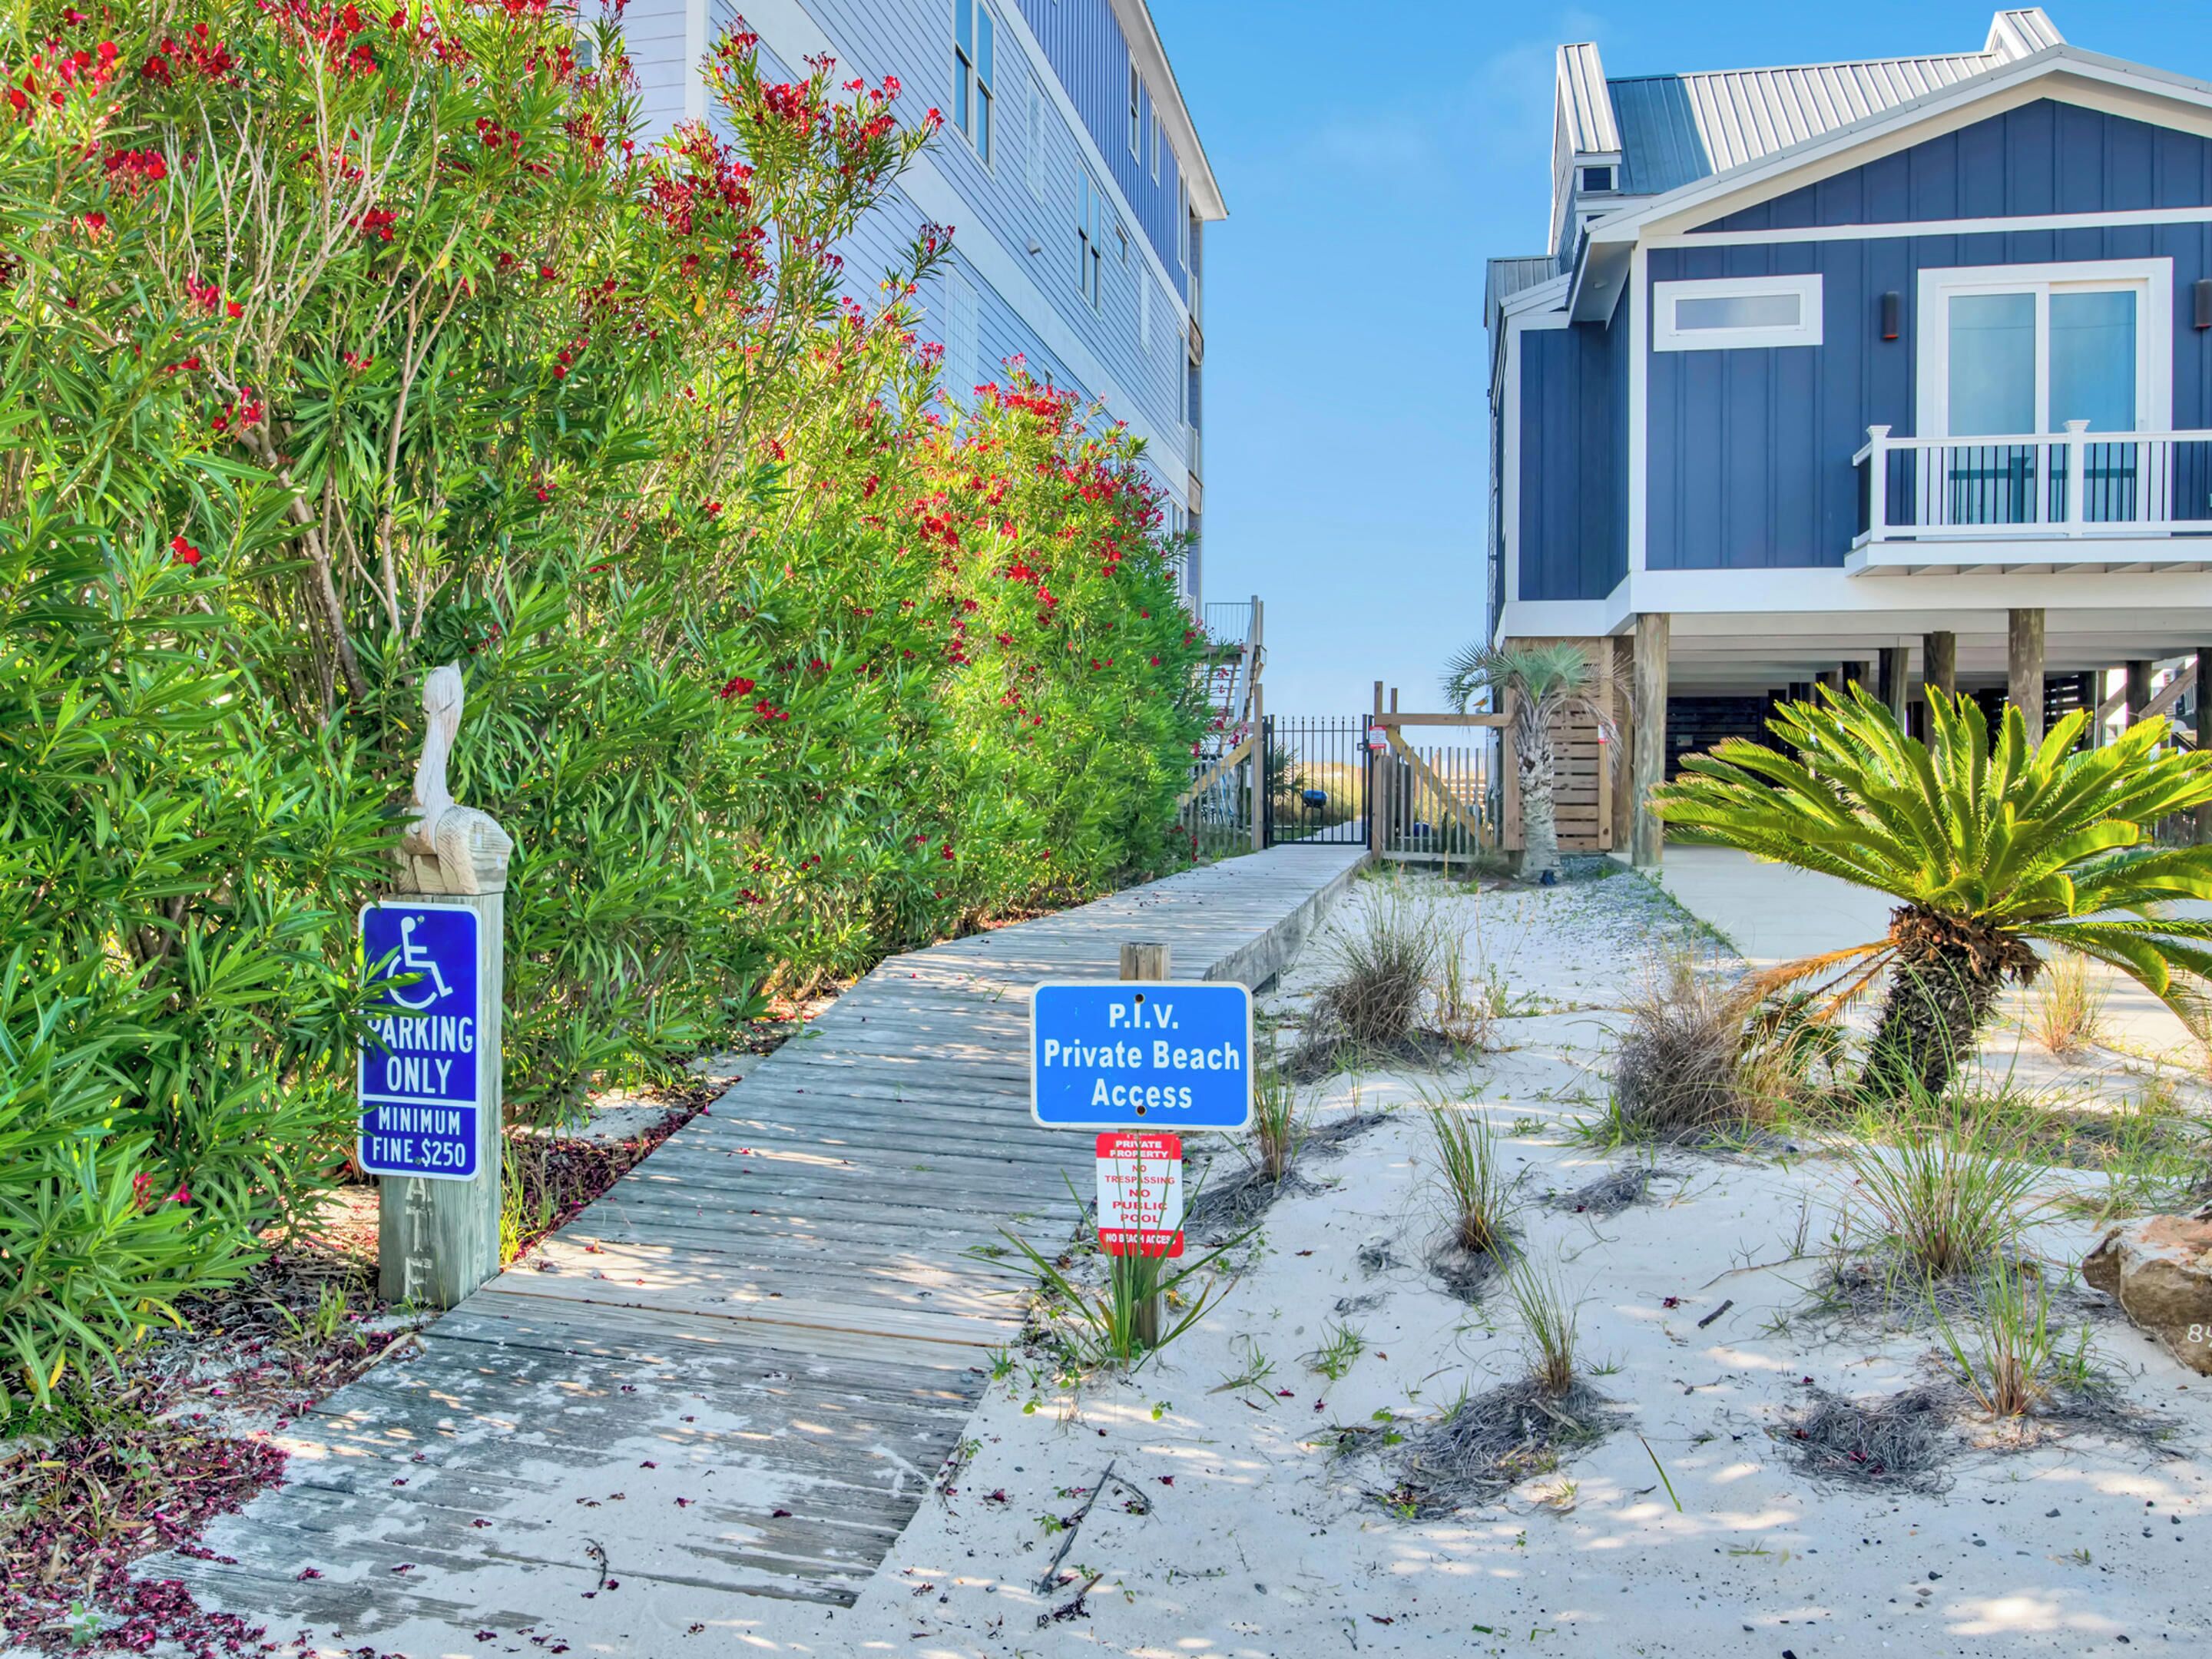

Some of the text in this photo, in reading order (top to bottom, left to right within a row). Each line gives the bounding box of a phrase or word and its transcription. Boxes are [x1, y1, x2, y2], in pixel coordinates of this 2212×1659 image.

[1109, 1003, 1179, 1029] P.I.V.
[1044, 1038, 1240, 1071] Private Beach
[386, 1055, 453, 1095] ONLY
[1091, 1078, 1193, 1109] Access
[378, 1105, 461, 1137] MINIMUM
[373, 1136, 466, 1168] FINE $250
[1131, 1164, 1147, 1172] NO
[1128, 1188, 1151, 1197] NO
[1120, 1214, 1160, 1223] POOL
[1106, 1232, 1117, 1242] NO
